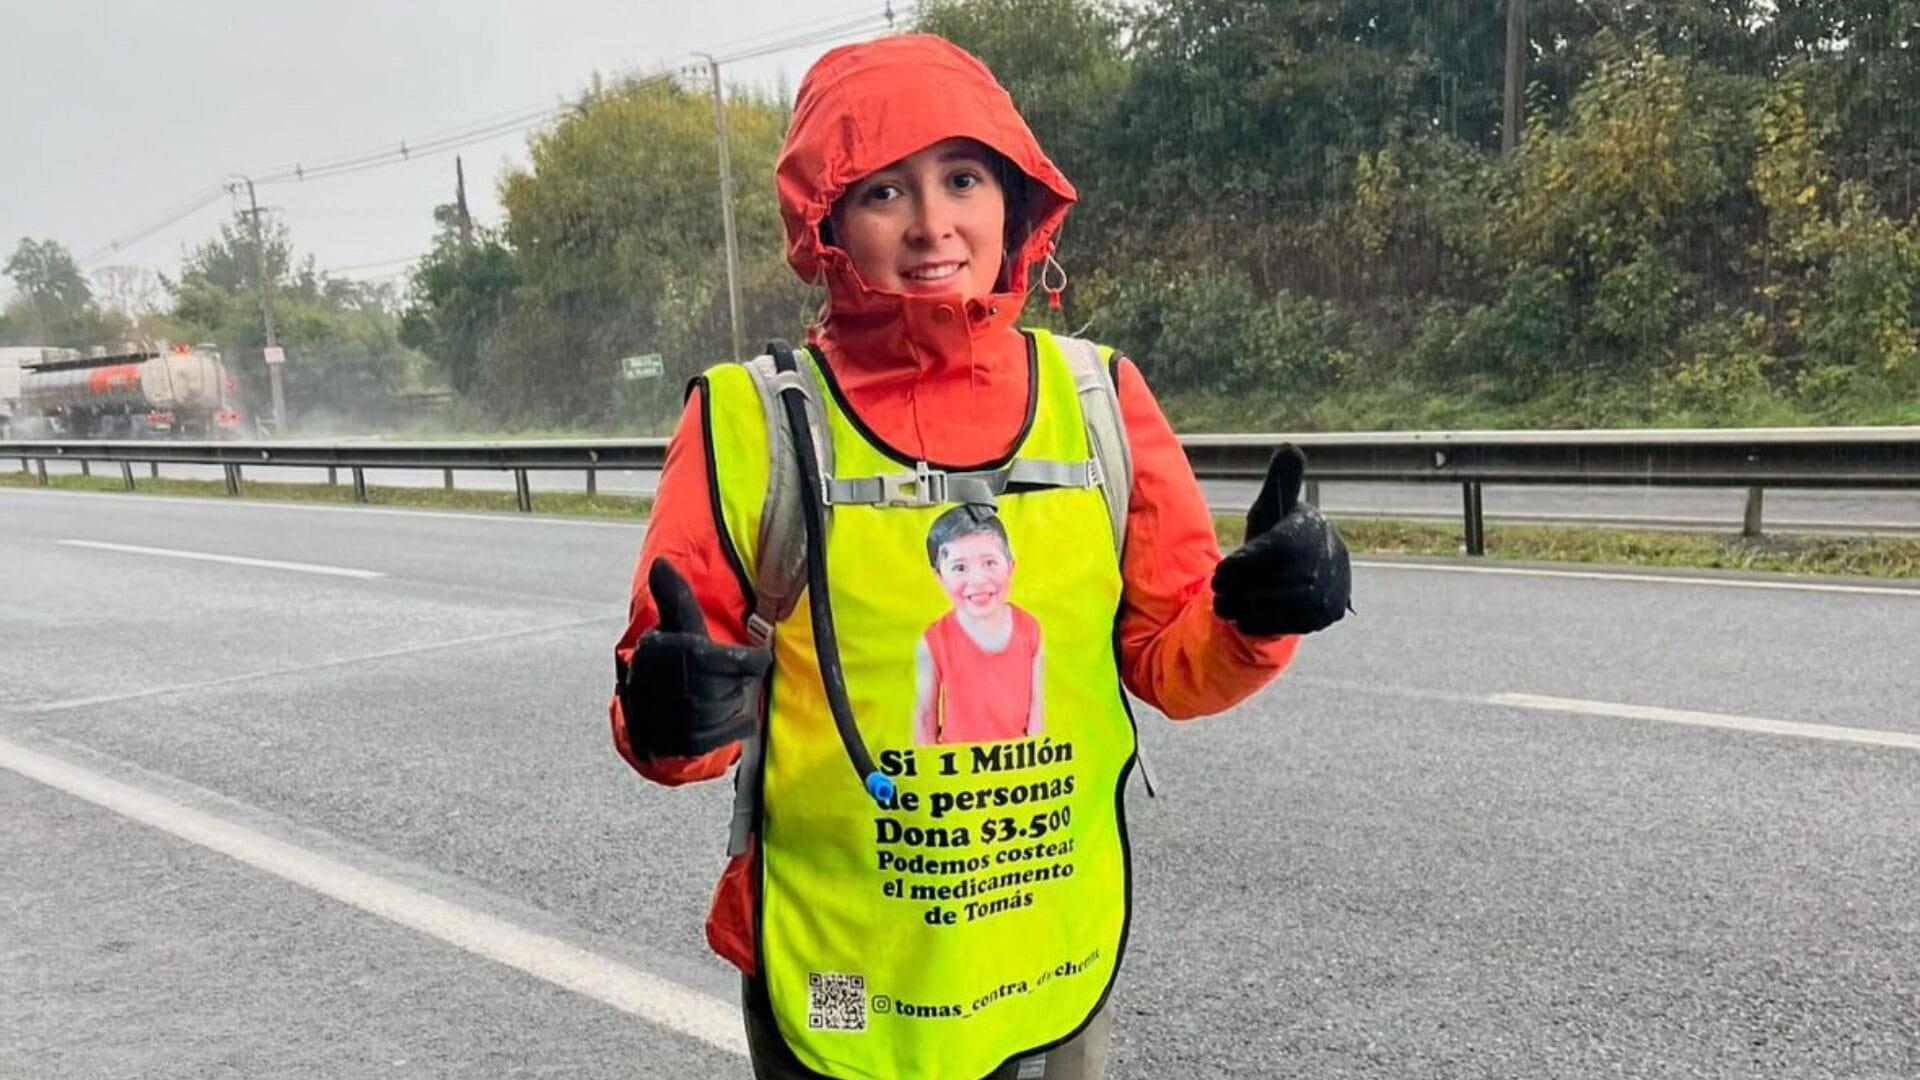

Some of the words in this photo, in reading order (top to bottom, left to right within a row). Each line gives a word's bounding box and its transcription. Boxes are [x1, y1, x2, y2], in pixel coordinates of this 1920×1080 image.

[879, 750, 918, 777] Si
[939, 752, 959, 776] 1
[971, 738, 1073, 774] Millón
[929, 775, 1075, 818] personas
[875, 818, 970, 848] Dona
[980, 805, 1071, 844] $3.500
[877, 850, 990, 875] Podemos
[883, 879, 904, 898] el
[910, 863, 1074, 901] medicamento
[925, 906, 957, 925] de
[964, 890, 1033, 922] Tomás
